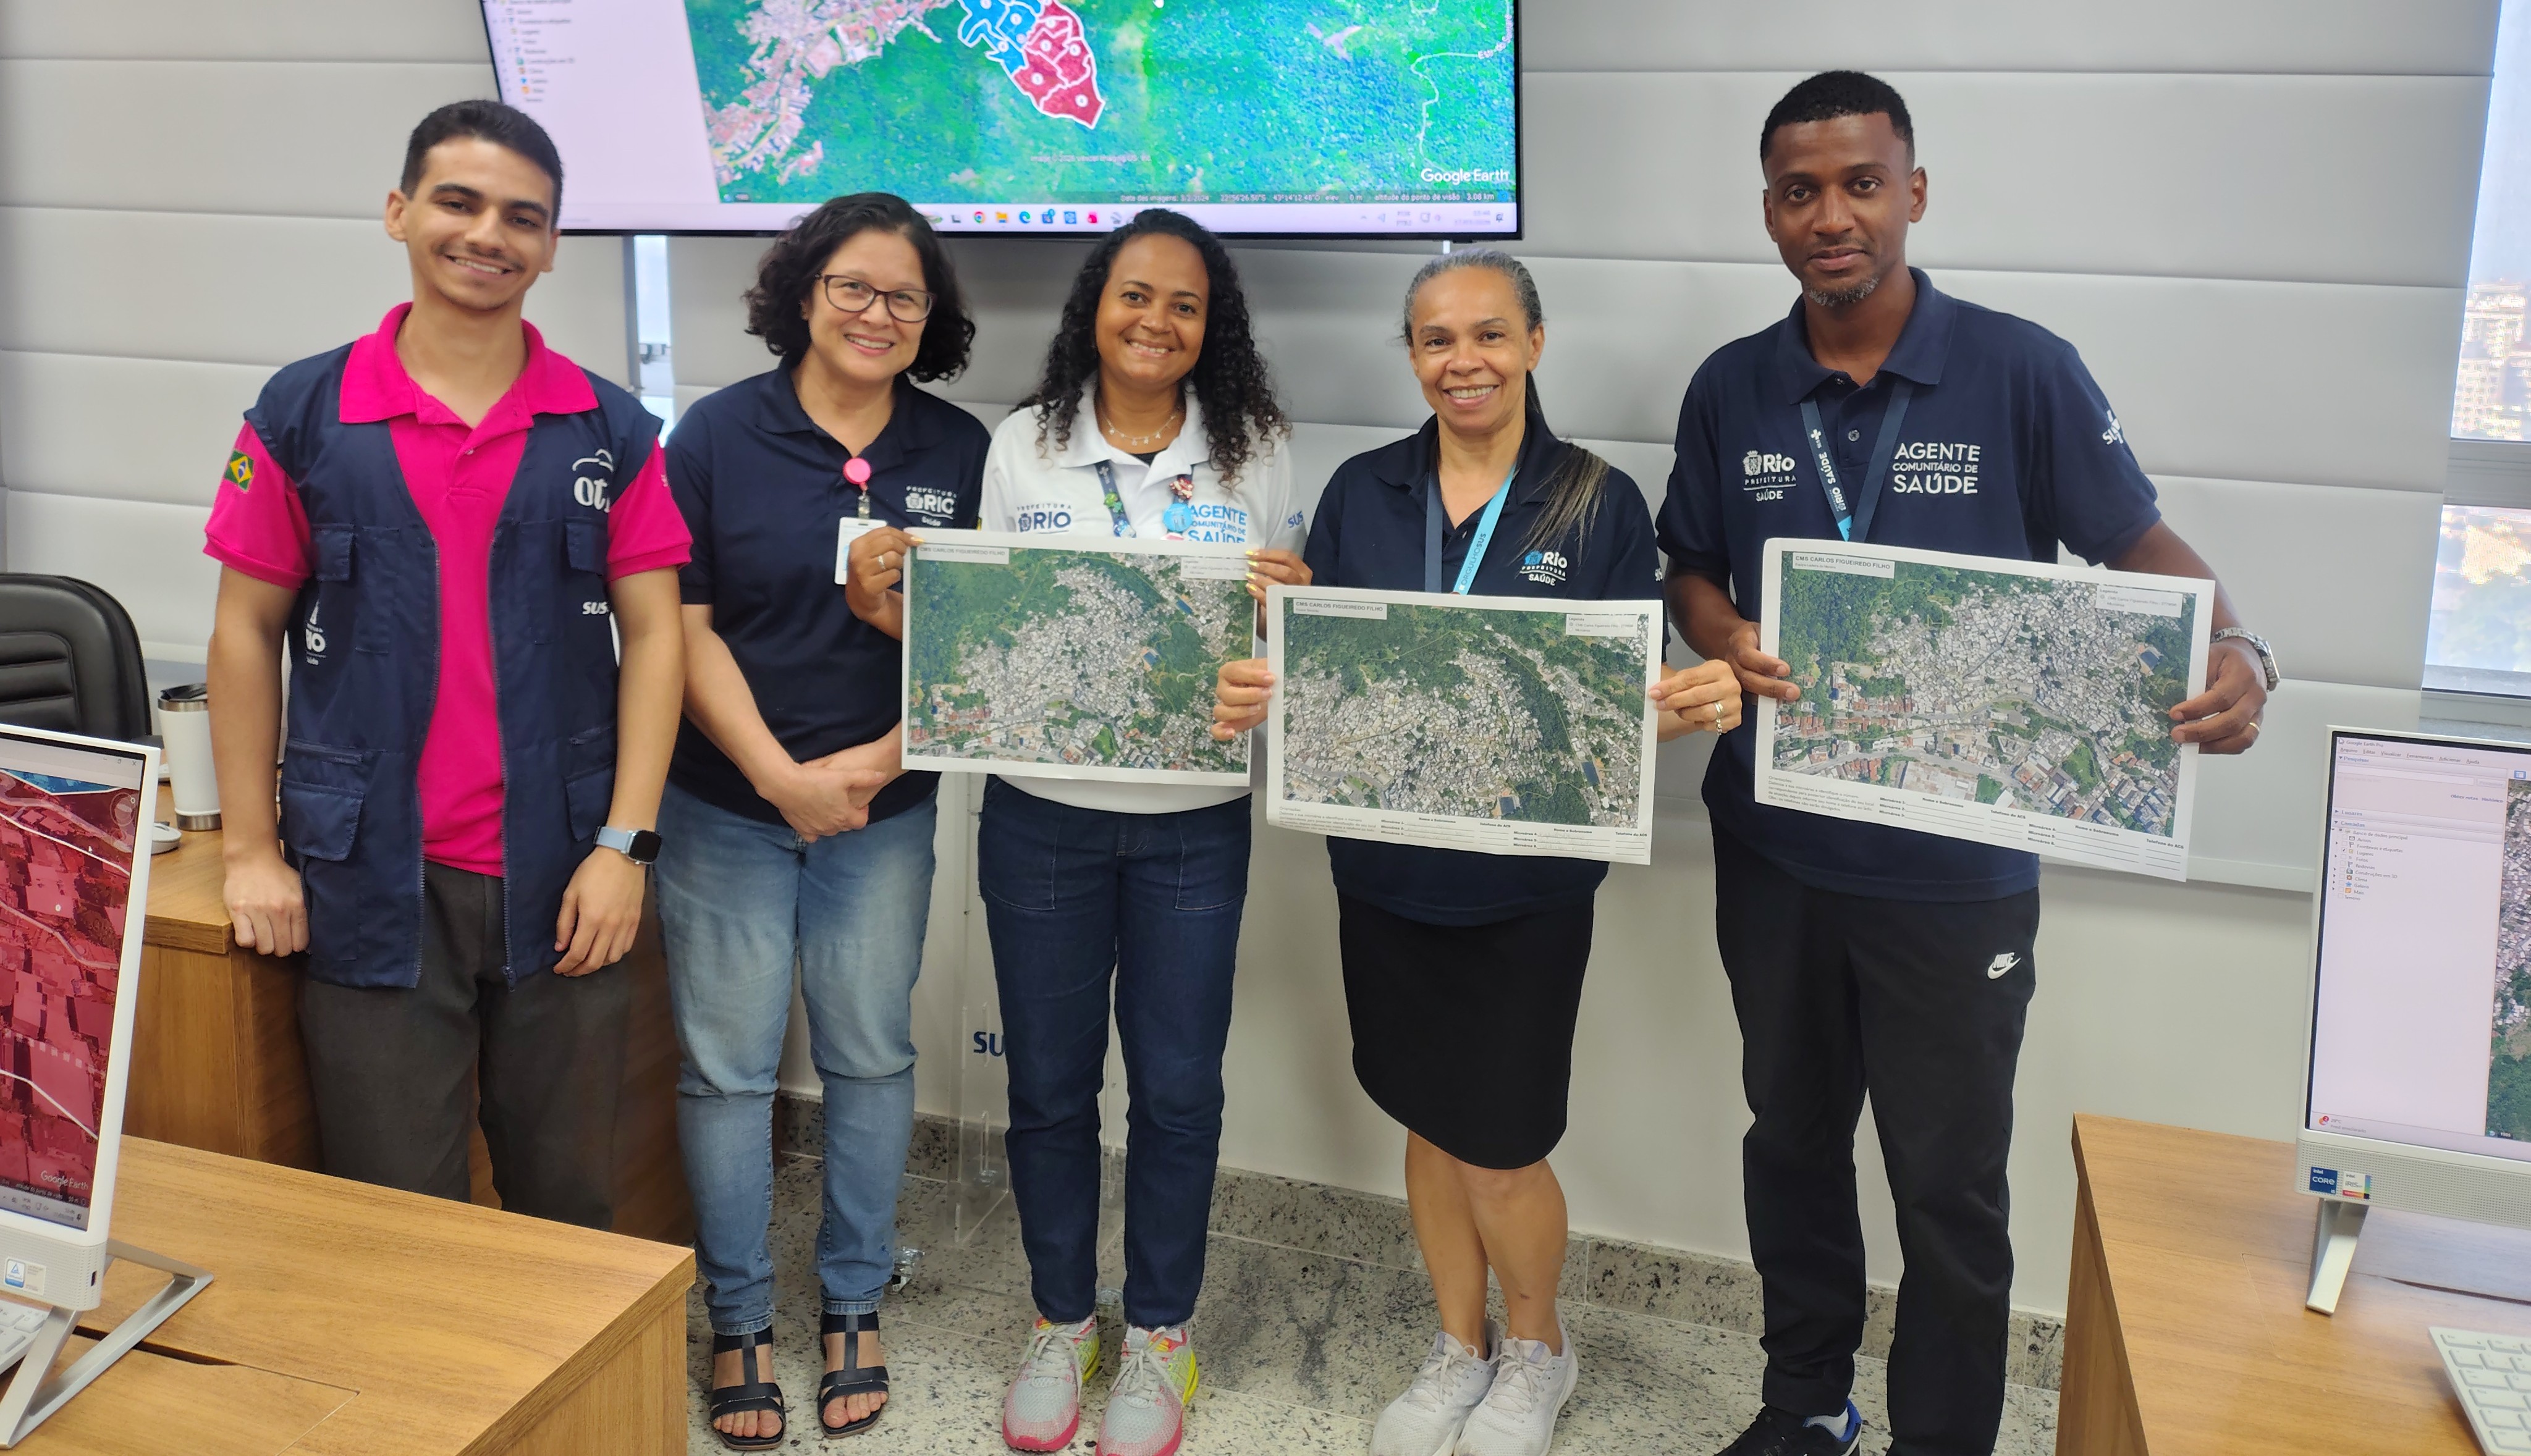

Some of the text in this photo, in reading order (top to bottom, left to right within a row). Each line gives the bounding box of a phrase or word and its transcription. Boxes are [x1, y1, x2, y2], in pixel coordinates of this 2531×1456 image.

[1421, 168, 1509, 185] Google Earth
[1895, 442, 1980, 461] AGENTE
[1764, 453, 1795, 473] Rio
[1893, 461, 1978, 473] COMUNITÁRIO DE
[1819, 452, 1844, 504] RIO SAÚDE
[1893, 473, 1978, 494] SAÚDE
[1756, 489, 1783, 502] SAÚDE
[1034, 511, 1071, 529] RIO
[1191, 504, 1247, 525] AGENTE
[1288, 510, 1304, 528] SUS
[1192, 520, 1246, 536] OMUNITÁRIO DE
[1542, 552, 1567, 568] Rio
[1836, 559, 1872, 567] FIGUEIREDO
[1529, 574, 1556, 586] SAÚDE
[974, 1032, 1004, 1056] SU
[41, 1171, 88, 1190] Google Earth
